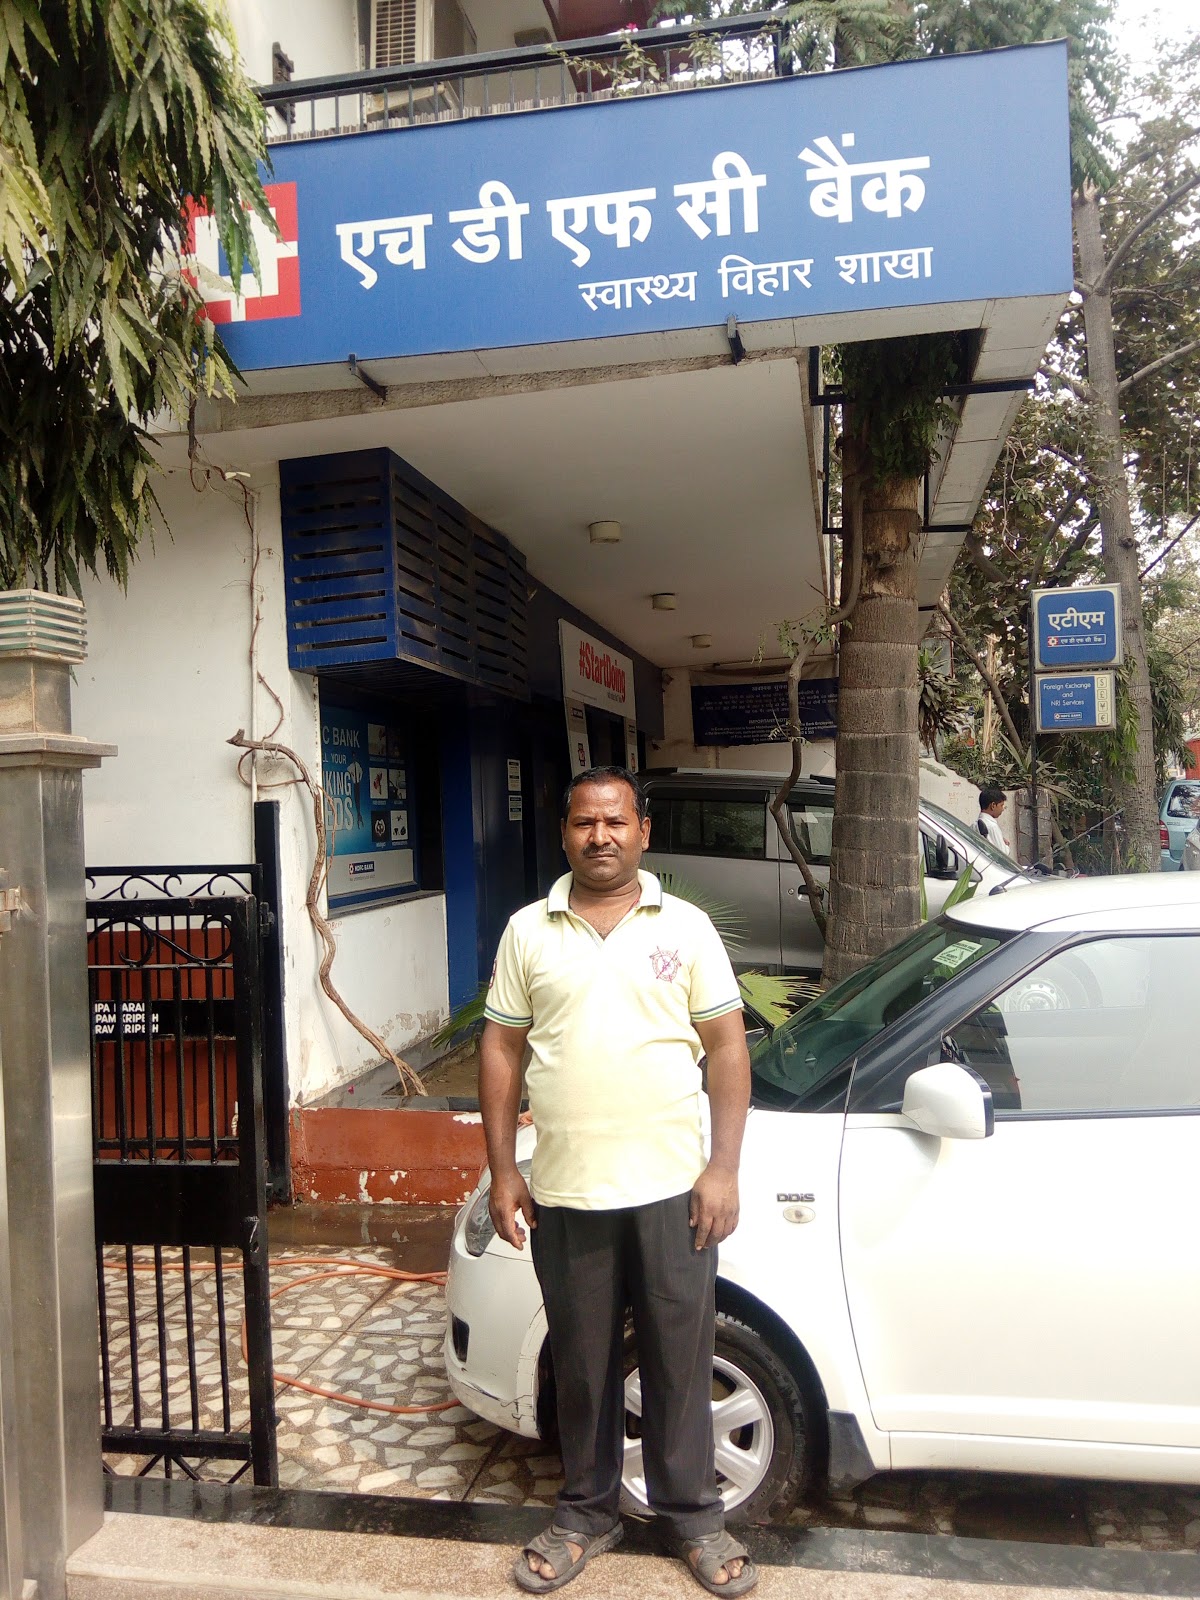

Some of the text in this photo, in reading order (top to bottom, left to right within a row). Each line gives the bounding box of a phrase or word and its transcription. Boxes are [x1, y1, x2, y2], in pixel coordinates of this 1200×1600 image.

[335, 132, 931, 290] एच डी एफ सी बैंक
[578, 246, 934, 312] स्वास्थ्य विहार शाखा
[1047, 607, 1106, 631] एटीएम
[578, 640, 626, 703] #StartDoing
[1043, 682, 1091, 691] Foreign Exchange
[332, 727, 360, 748] BANK
[331, 753, 347, 764] YOUR
